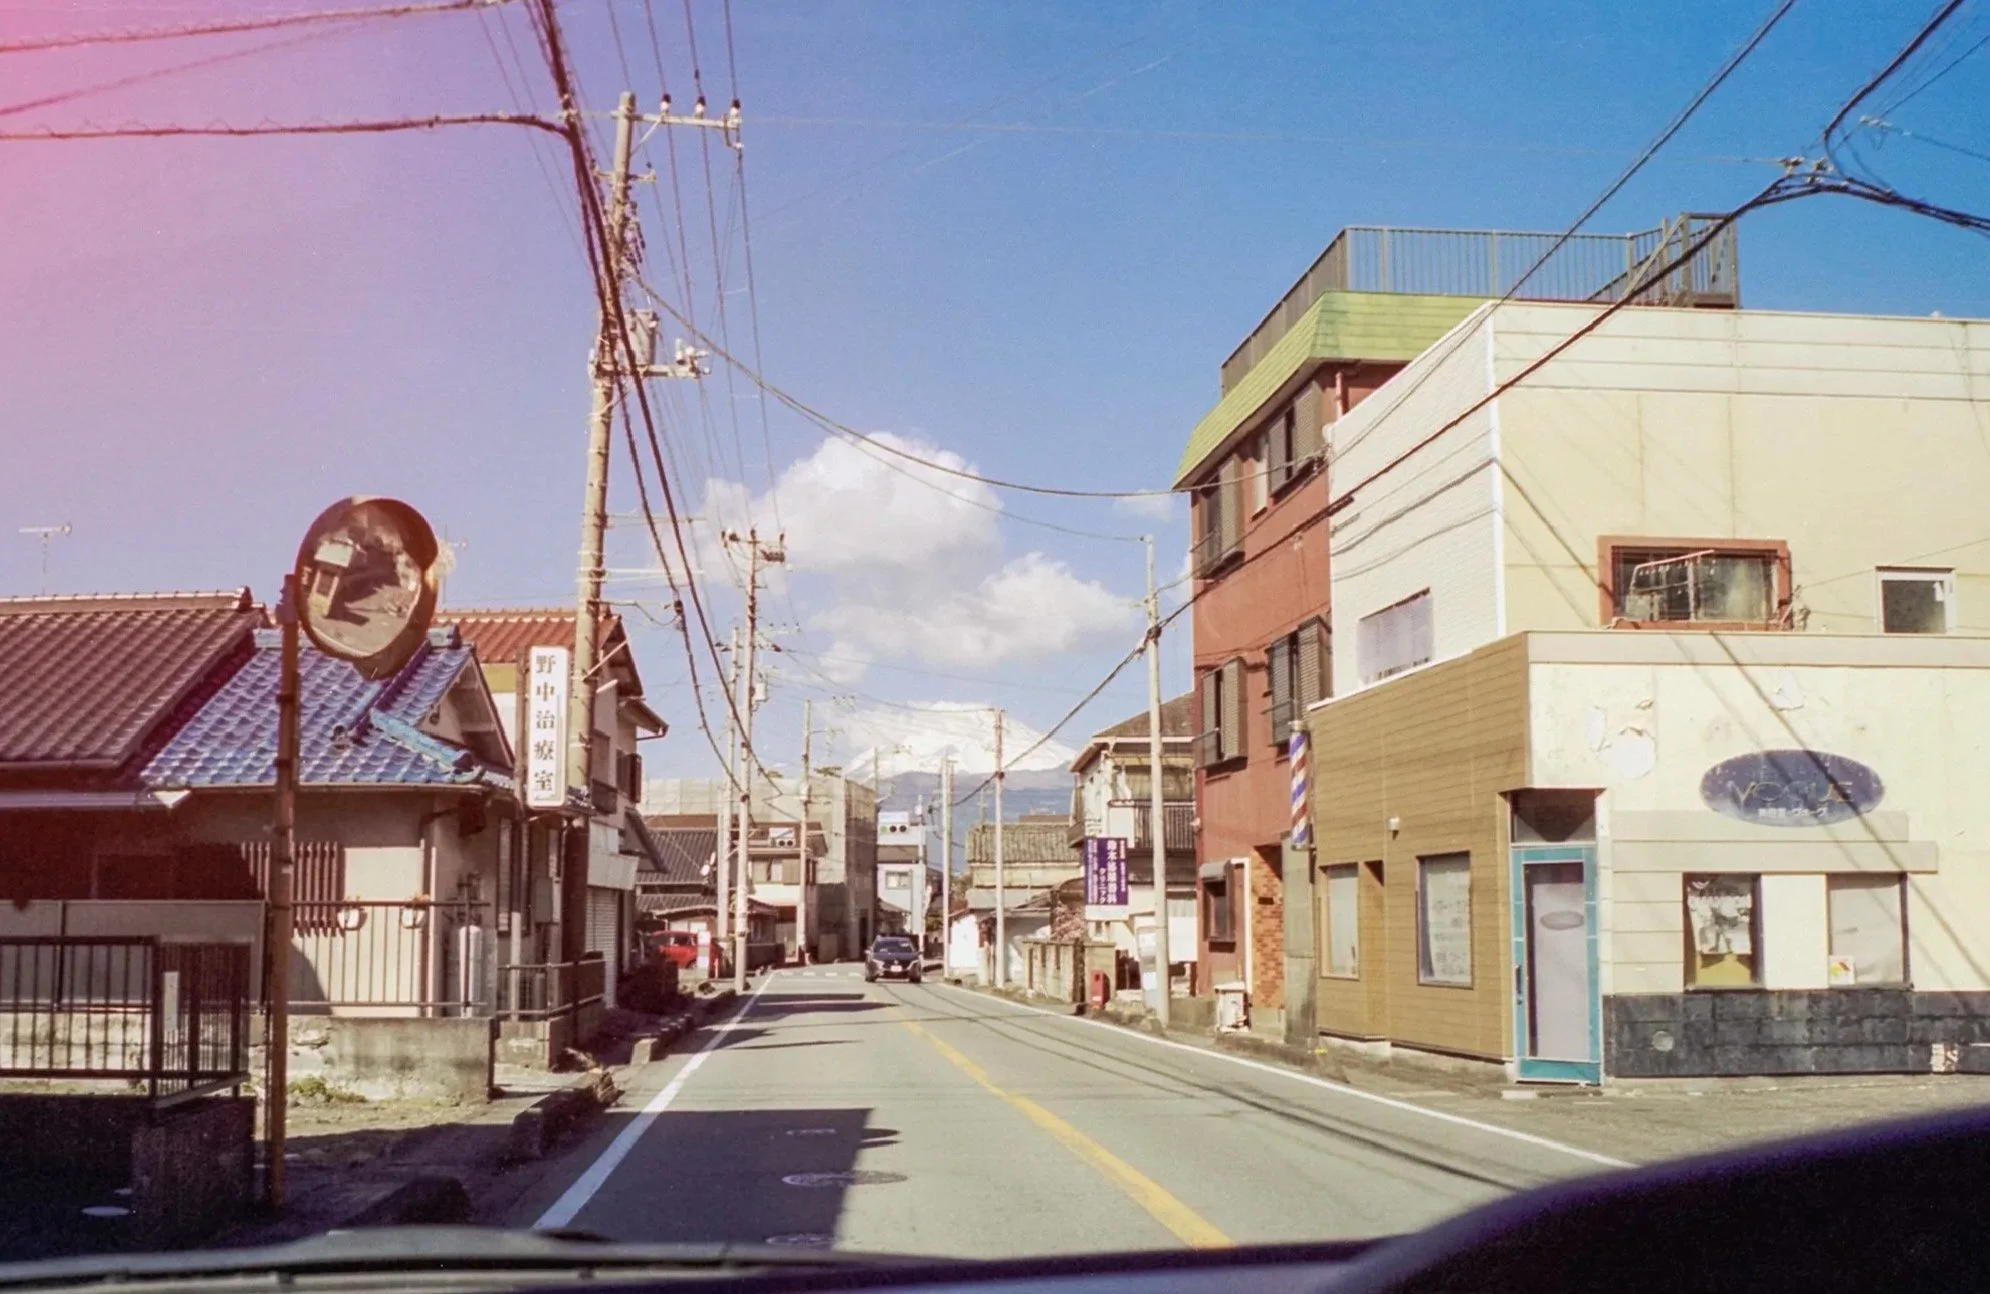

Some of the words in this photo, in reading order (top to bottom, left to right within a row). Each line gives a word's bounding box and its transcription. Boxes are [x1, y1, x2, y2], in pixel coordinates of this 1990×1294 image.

[534, 654, 556, 792] 野中治療室
